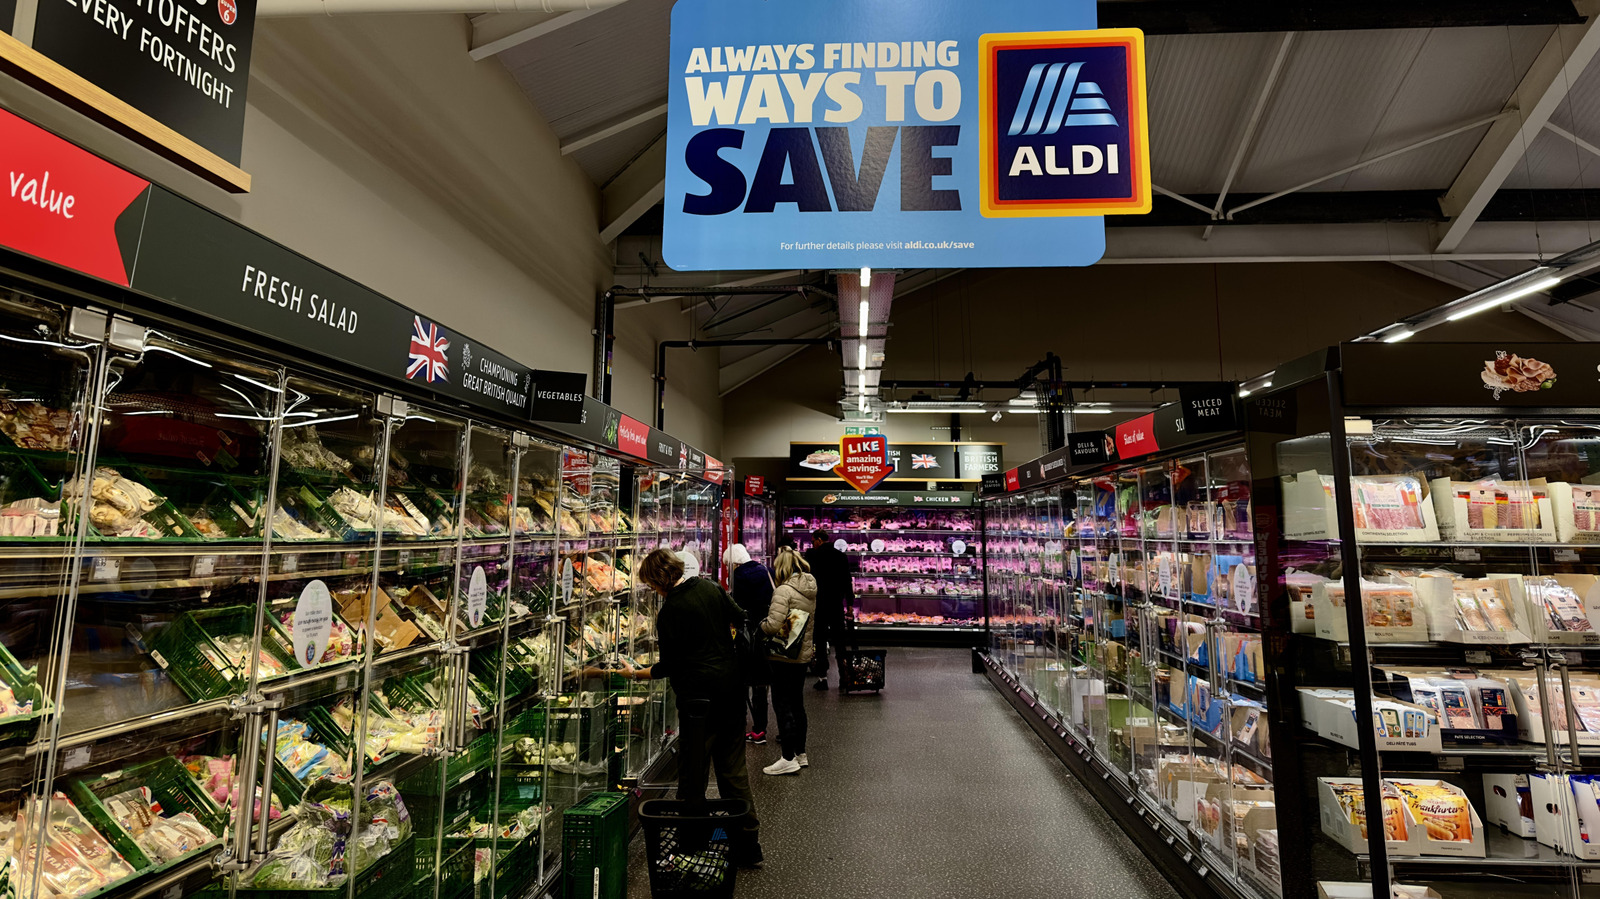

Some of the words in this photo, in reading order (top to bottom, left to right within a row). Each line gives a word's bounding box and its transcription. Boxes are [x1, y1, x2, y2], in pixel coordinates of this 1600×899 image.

[223, 10, 230, 22] 6
[66, 0, 133, 40] VERY
[140, 28, 234, 109] FORTNIGHT
[685, 43, 814, 74] ALWAYS
[824, 40, 960, 69] FINDING
[685, 71, 863, 126] WAYS
[875, 70, 962, 122] TO
[1008, 144, 1119, 176] ALDI
[682, 125, 962, 216] SAVE
[10, 171, 75, 219] value
[780, 242, 794, 250] For
[795, 241, 825, 250] further
[826, 241, 854, 250] details
[856, 242, 885, 251] please
[886, 241, 903, 249] visit
[904, 240, 975, 249] aldi.co.uk/save
[241, 264, 303, 313] FRESH
[307, 293, 358, 334] SALAD
[479, 357, 518, 386] CHAMPIONING
[462, 372, 483, 392] GREAT
[483, 380, 506, 401] BRITISH
[505, 389, 527, 409] QUALITY
[537, 390, 583, 402] VEGETABLES
[1191, 398, 1222, 409] SLICED
[1197, 407, 1220, 417] MEAT
[1175, 417, 1185, 432] SLI
[848, 440, 880, 454] LIKE
[1074, 447, 1099, 455] SAVOURY
[846, 455, 882, 464] amazing
[964, 455, 998, 463] BRITISH
[847, 464, 882, 474] savings.
[964, 463, 999, 471] FARMERS
[1411, 800, 1464, 814] Frankfurters
